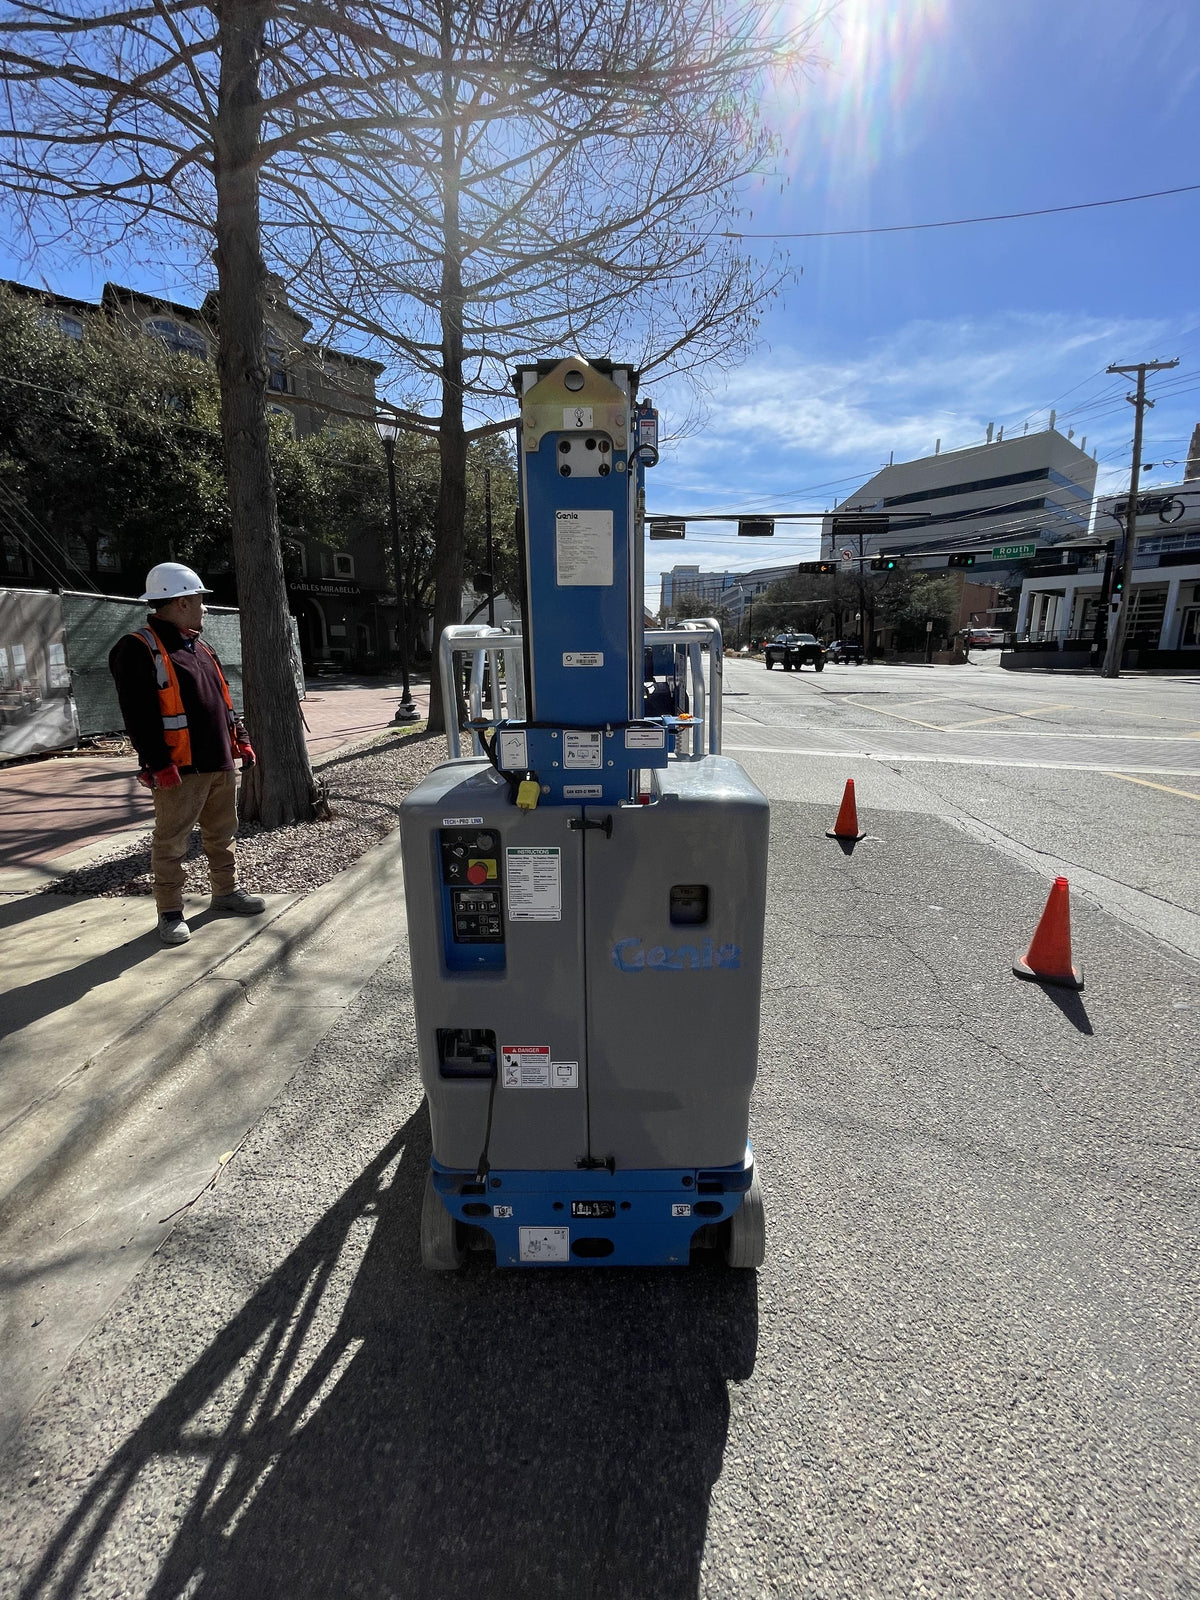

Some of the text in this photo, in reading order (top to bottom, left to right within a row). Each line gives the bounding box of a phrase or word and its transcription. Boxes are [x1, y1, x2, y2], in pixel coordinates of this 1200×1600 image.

[556, 511, 579, 520] Genie
[999, 545, 1029, 555] Routh
[290, 582, 320, 592] GABLES
[320, 585, 361, 594] MIRABELLA
[611, 936, 742, 974] Genie
